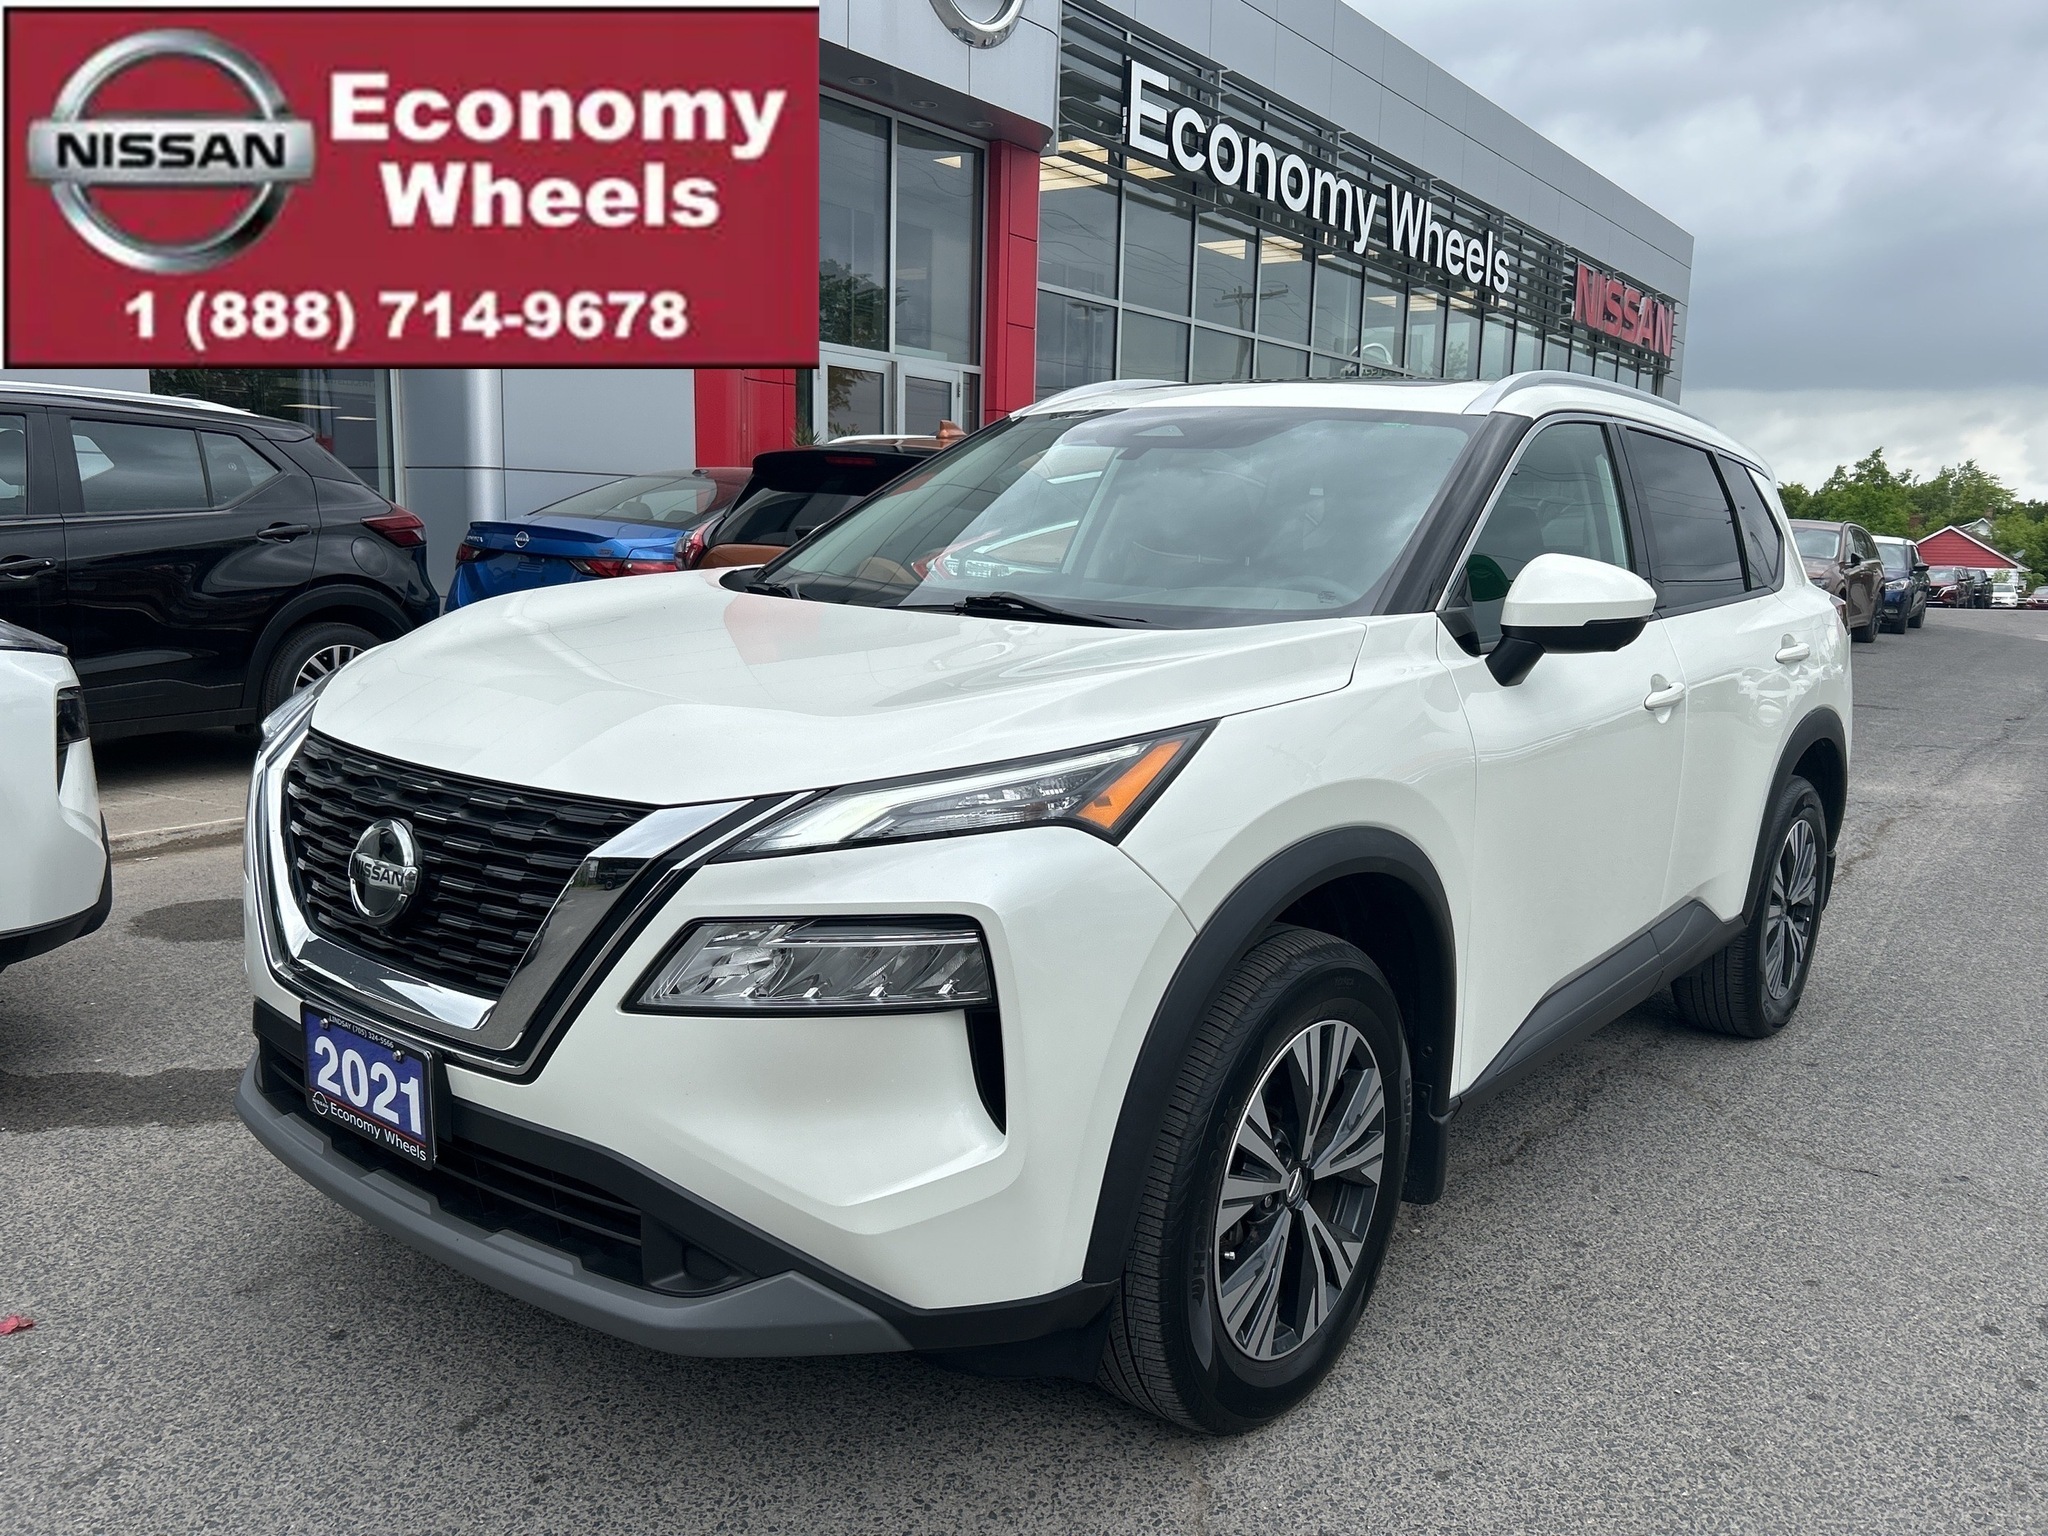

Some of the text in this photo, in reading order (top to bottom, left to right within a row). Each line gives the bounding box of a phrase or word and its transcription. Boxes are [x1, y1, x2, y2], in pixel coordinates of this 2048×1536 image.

[1126, 59, 1510, 293] Economy Wheels
[1575, 263, 1673, 357] NISSAN
[354, 860, 405, 887] NISSAN
[328, 1015, 352, 1030] LINDSAY
[352, 1025, 368, 1038] (705)
[314, 1036, 422, 1135] 2021
[330, 1102, 427, 1161] Economy Wheels
